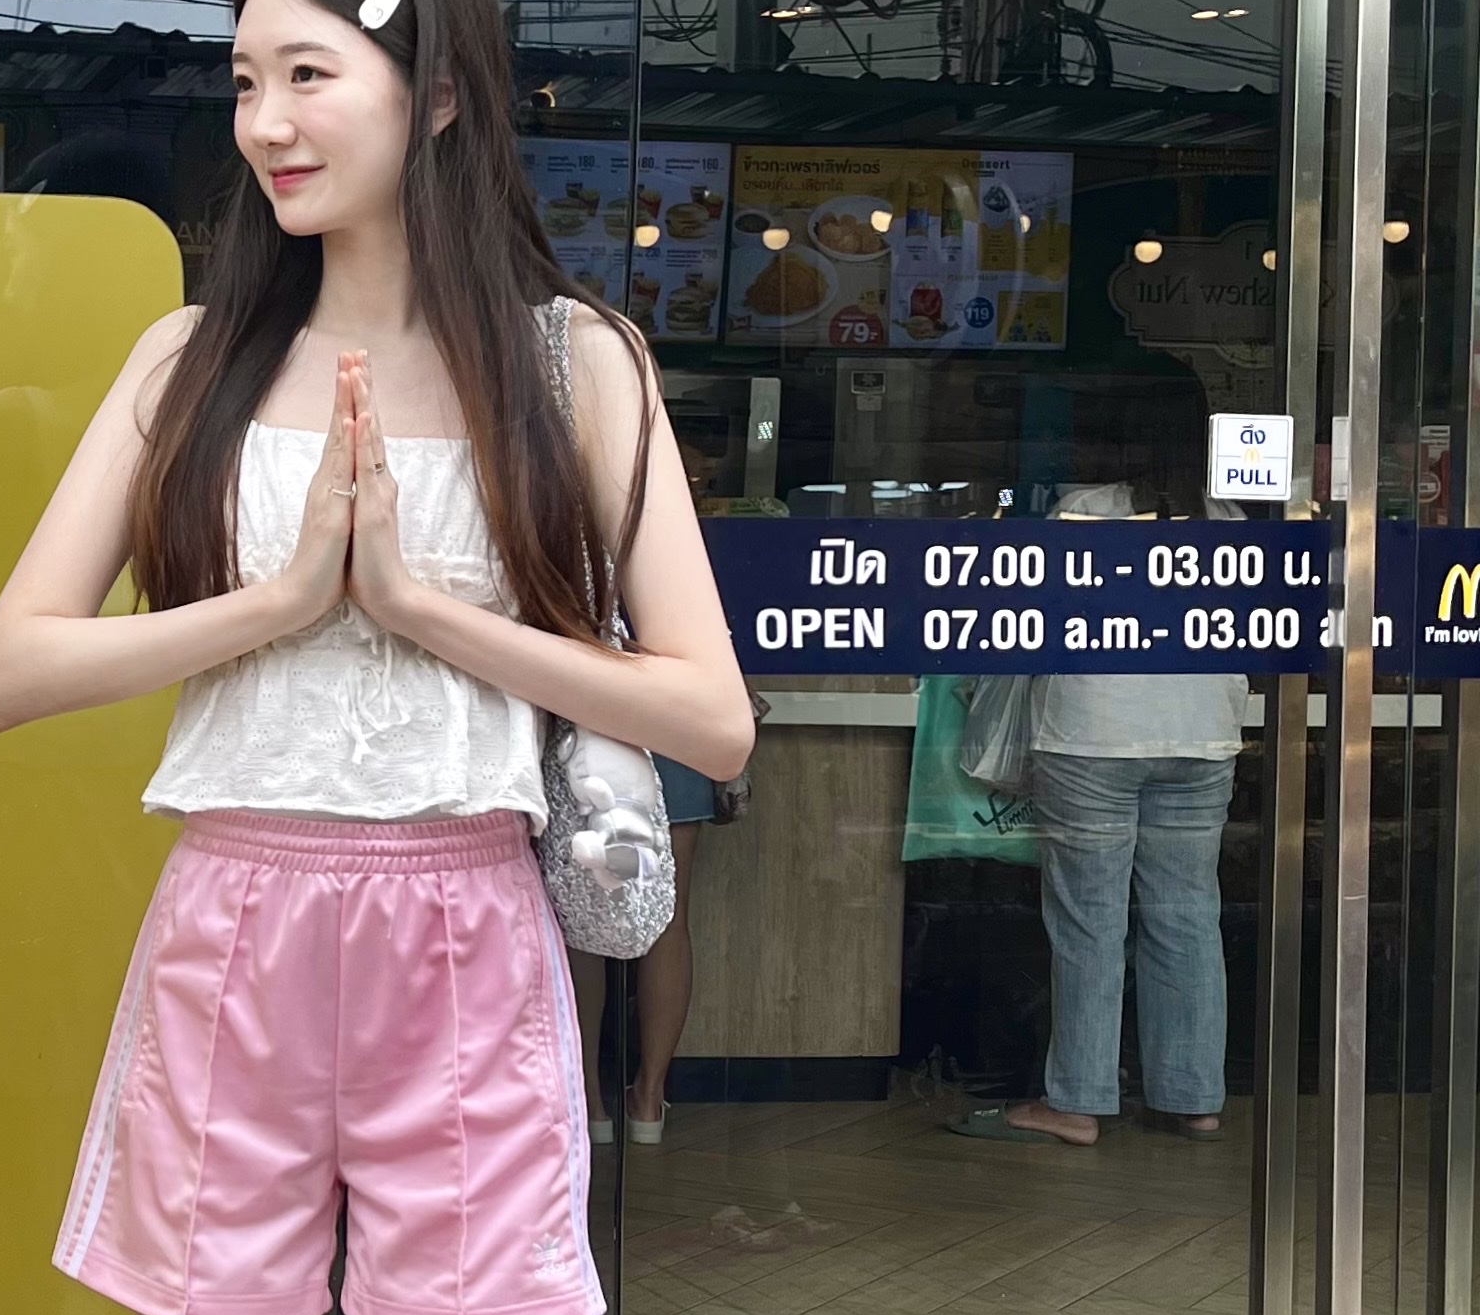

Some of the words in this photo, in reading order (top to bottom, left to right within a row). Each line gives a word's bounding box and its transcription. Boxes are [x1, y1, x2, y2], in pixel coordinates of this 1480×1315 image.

[1239, 423, 1266, 445] ดึง
[1226, 468, 1278, 486] PULL
[810, 538, 887, 585] เปิด
[924, 545, 1045, 587] 07.00
[1148, 545, 1264, 587] 03.00
[756, 608, 884, 650] OPEN
[923, 609, 1044, 650] 07.00
[1184, 608, 1300, 649] 03.00
[1425, 626, 1451, 643] I'm
